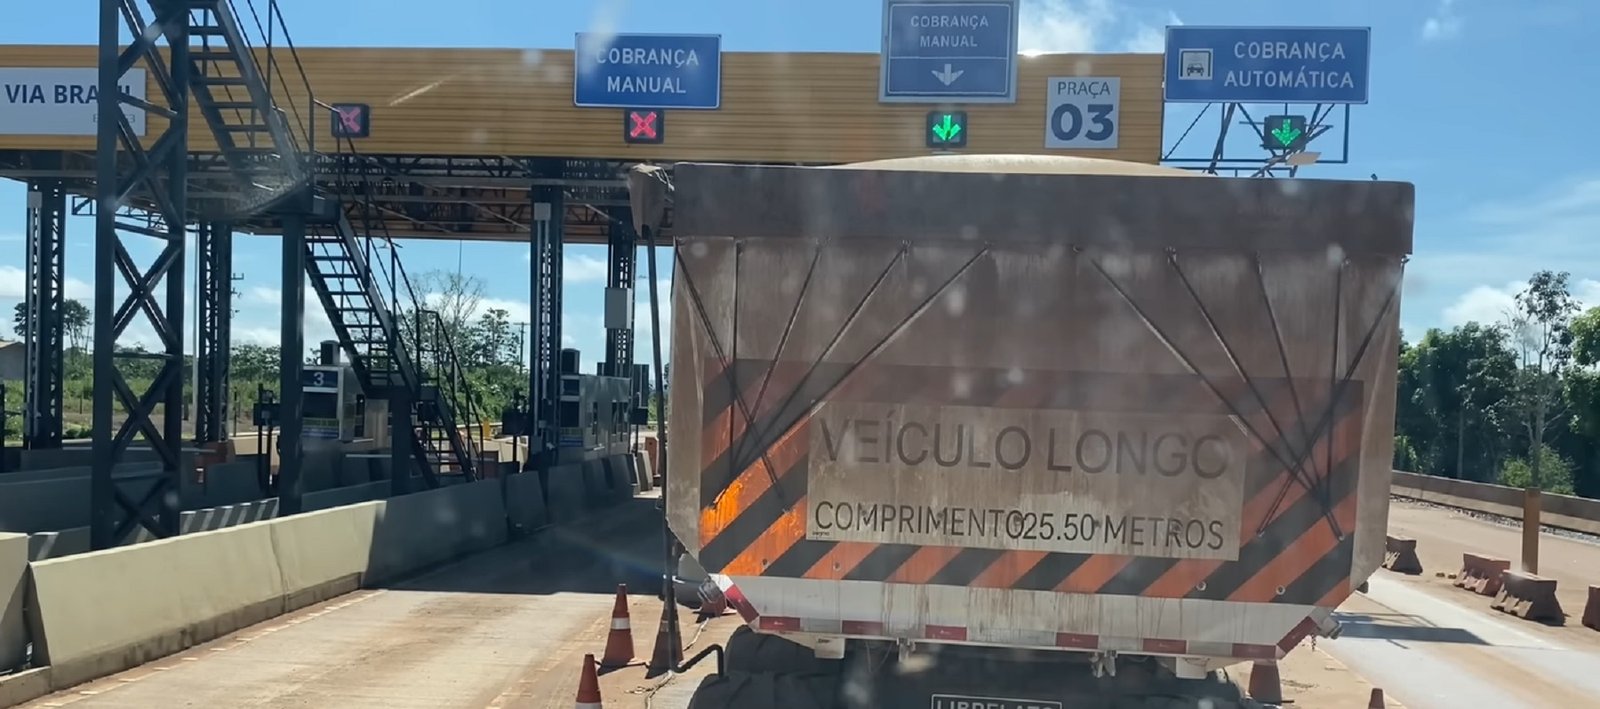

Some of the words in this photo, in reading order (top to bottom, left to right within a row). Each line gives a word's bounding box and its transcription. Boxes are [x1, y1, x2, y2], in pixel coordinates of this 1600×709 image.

[910, 15, 989, 30] COBRANÇA
[920, 35, 978, 48] MANUAL
[1234, 41, 1346, 62] COBRANÇA
[596, 47, 699, 69] COBRANÇA
[607, 76, 687, 93] MANUAL
[1224, 65, 1354, 88] AUTOMÁTICA
[5, 84, 45, 104] VIA
[1057, 81, 1111, 99] PRAÇA
[1051, 103, 1114, 141] 03
[313, 371, 325, 386] 3
[820, 409, 1032, 470] VEÍCULO
[1047, 427, 1229, 479] LONGO
[1104, 514, 1224, 550] METROS
